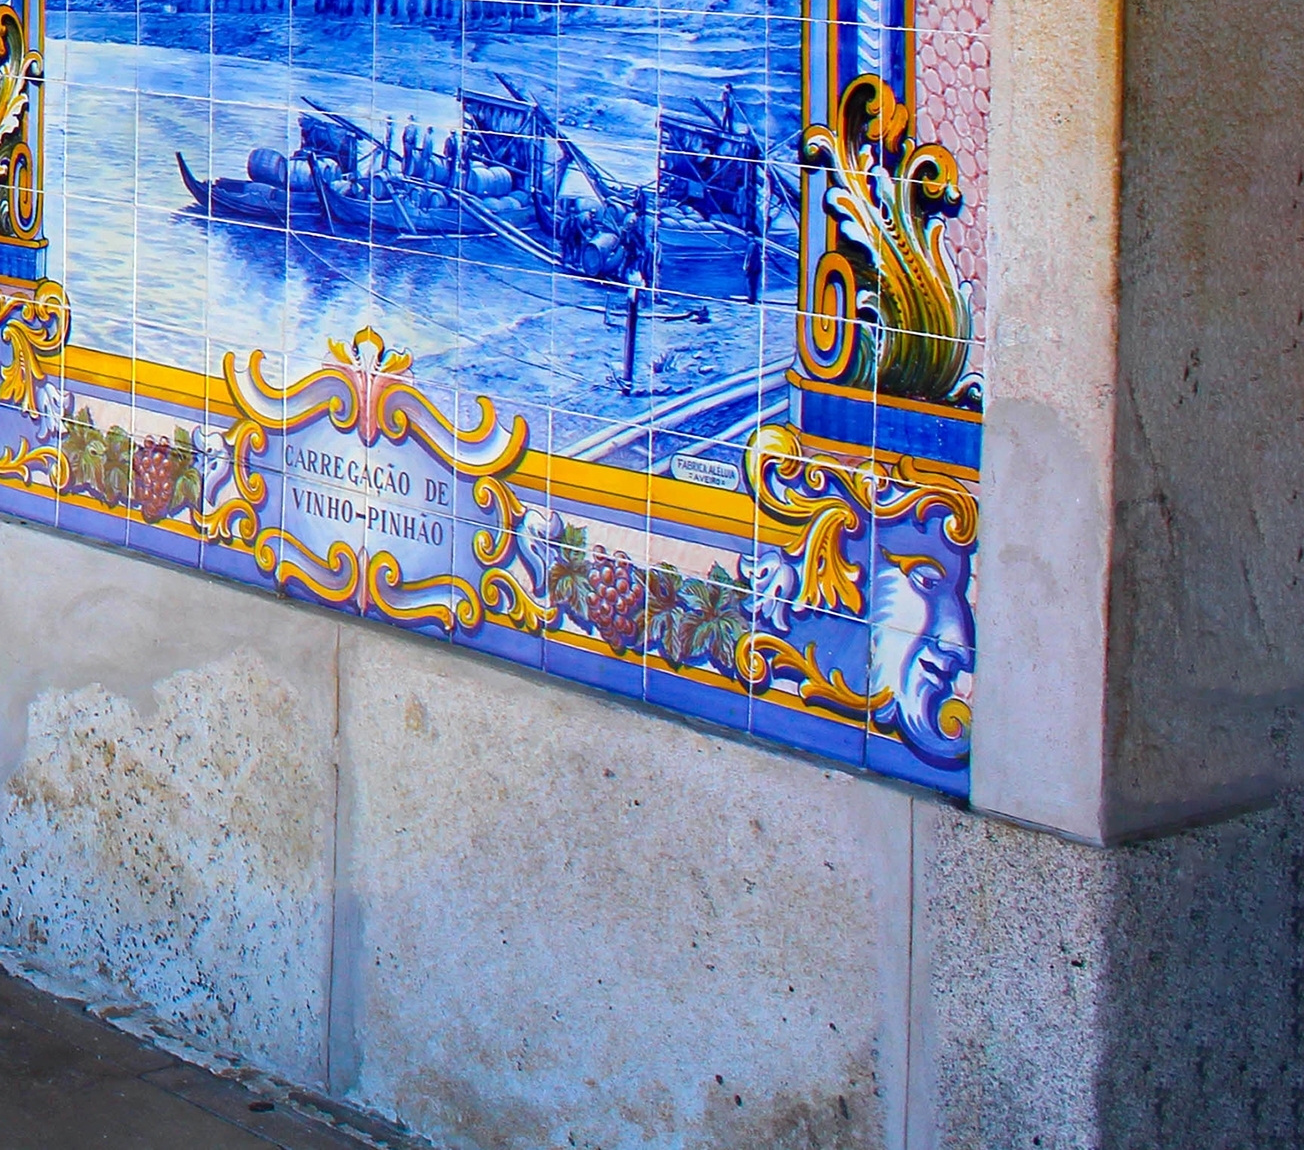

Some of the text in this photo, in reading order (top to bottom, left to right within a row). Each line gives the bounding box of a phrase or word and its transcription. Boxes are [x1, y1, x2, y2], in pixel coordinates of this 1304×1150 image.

[285, 444, 450, 506] CARREGAÇÃO DE
[292, 487, 444, 546] VINHO-PINHÃO
